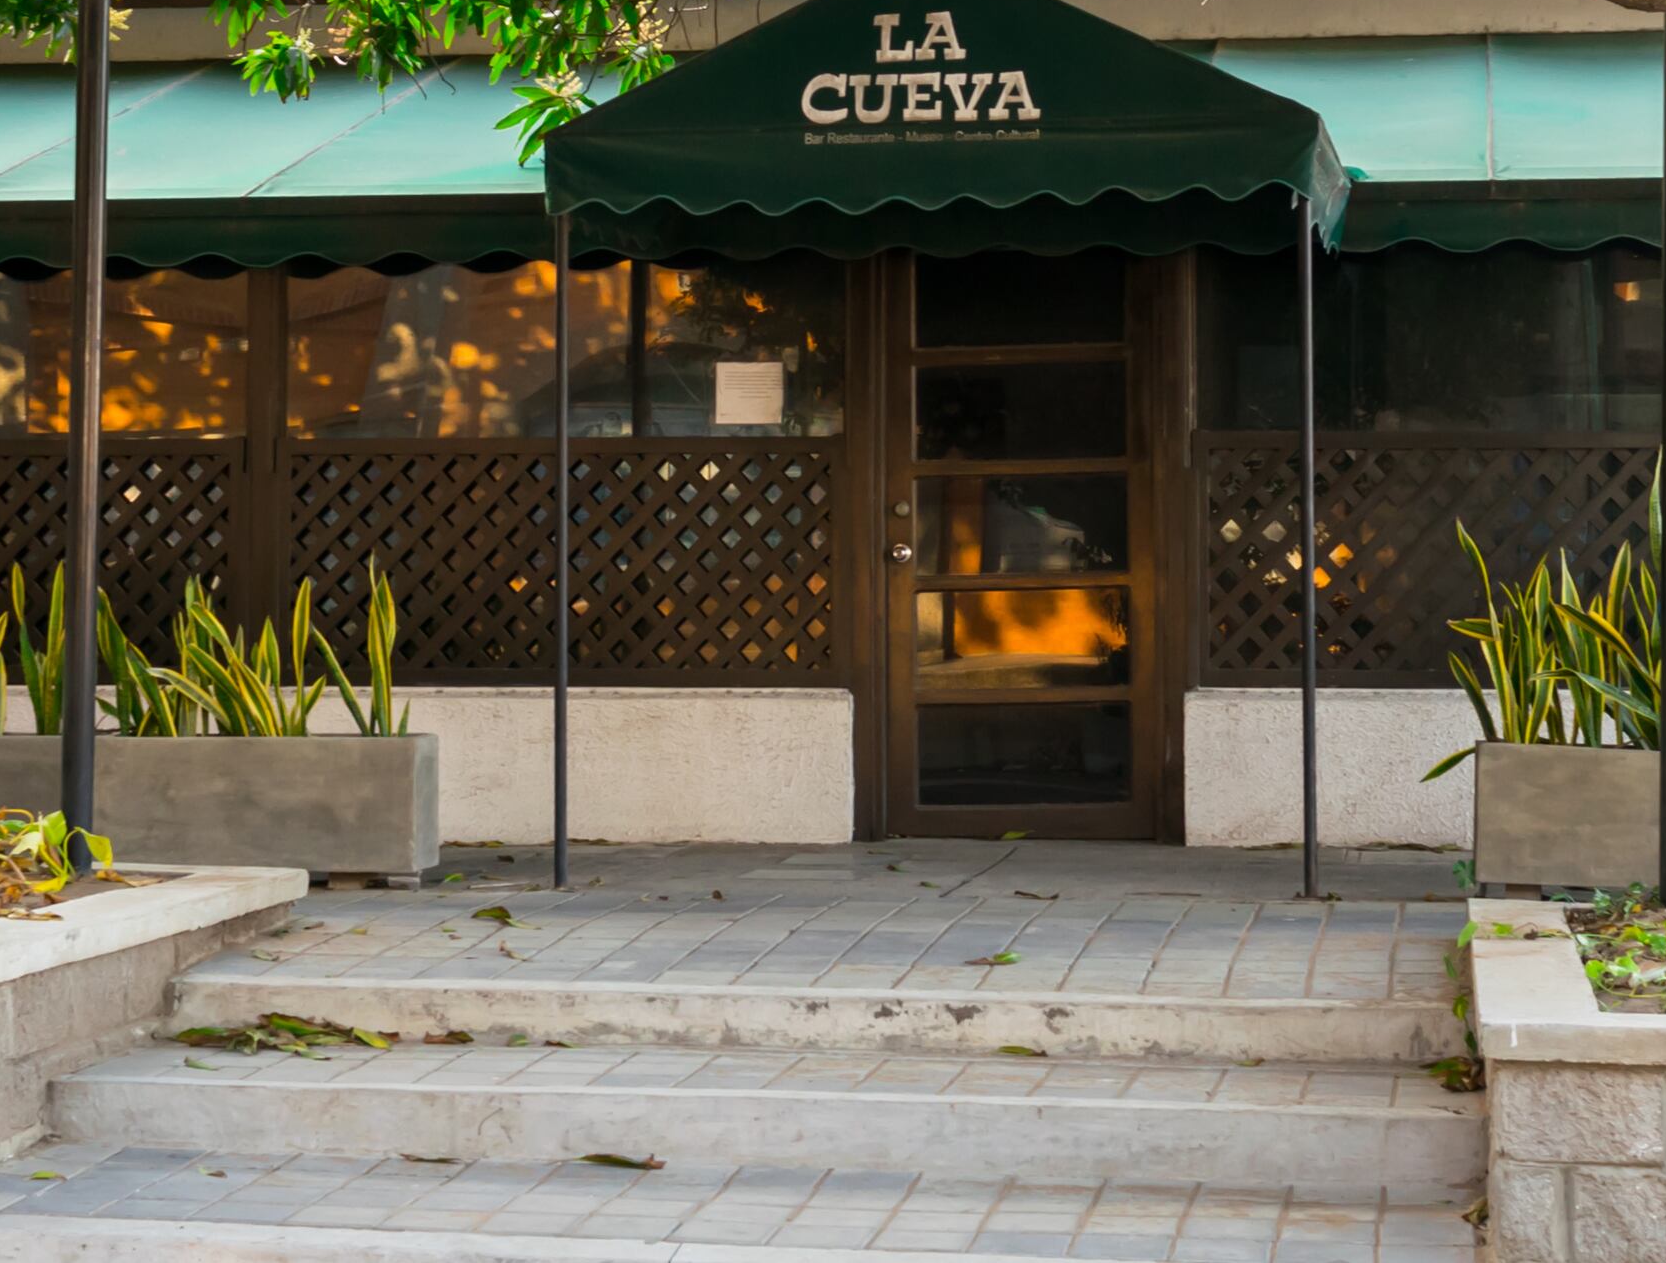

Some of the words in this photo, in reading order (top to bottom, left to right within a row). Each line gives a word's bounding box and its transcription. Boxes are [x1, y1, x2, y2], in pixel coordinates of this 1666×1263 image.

[873, 10, 967, 63] LA
[801, 70, 1041, 125] CUEVA
[804, 132, 825, 145] Bar
